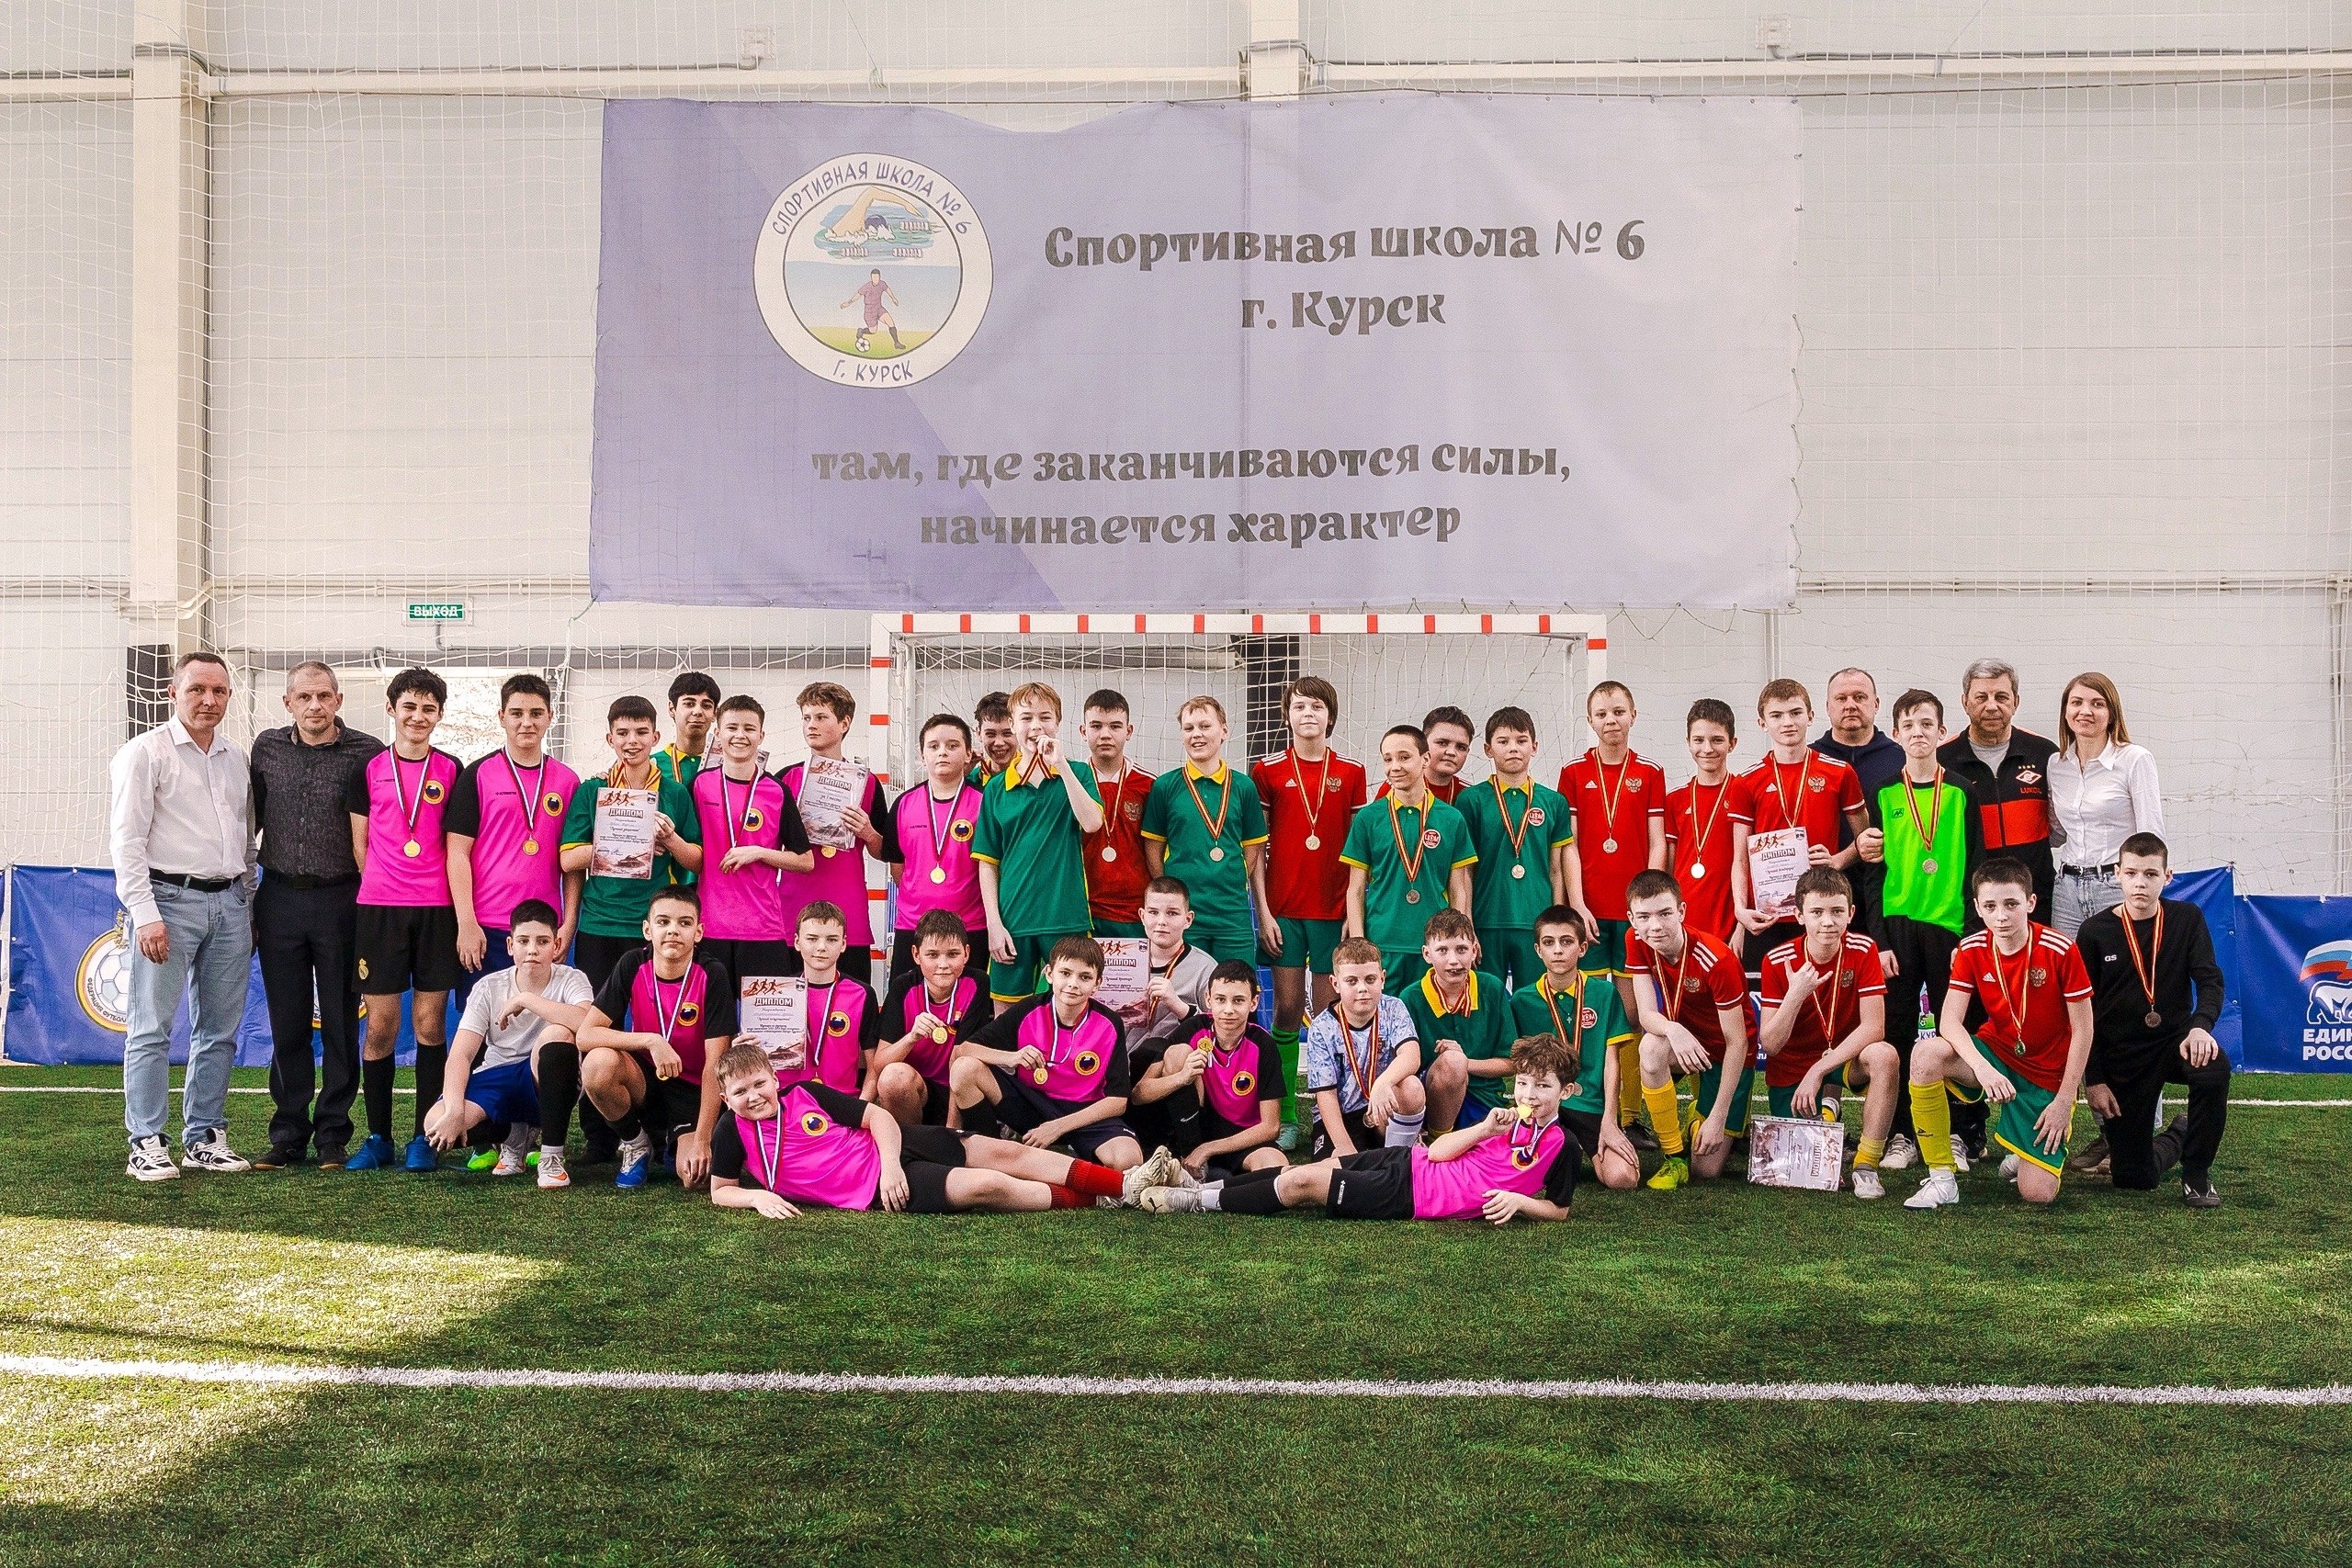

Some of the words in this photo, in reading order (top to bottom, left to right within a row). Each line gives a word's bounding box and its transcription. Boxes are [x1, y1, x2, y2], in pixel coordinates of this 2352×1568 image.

[772, 161, 868, 235] СПОРТИВНАЯ
[876, 162, 934, 197] ШКОЛА
[936, 194, 961, 217] №
[956, 220, 972, 234] 6
[1045, 225, 1357, 272] Спортивная
[1370, 224, 1540, 259] школа
[1554, 220, 1602, 255] №
[1615, 220, 1646, 261] 6
[1240, 297, 1277, 330] г.
[1290, 289, 1447, 336] Курск
[833, 359, 845, 378] Г.
[854, 359, 913, 382] КУРСК
[810, 451, 923, 487] там,
[937, 452, 1023, 490] где
[1033, 444, 1420, 482] заканчиваются
[1430, 443, 1571, 482] силы,
[920, 513, 1216, 546] начинается
[1227, 505, 1462, 548] характер
[413, 605, 458, 617] ВЫХОД
[817, 775, 853, 792] ДИПЛОМ
[608, 807, 643, 818] ДИПЛОМ
[1761, 847, 1796, 862] ДИПЛОМ
[86, 976, 104, 1013] ФЕДЕРАЦИЯ
[754, 997, 793, 1007] ДИПЛОМ
